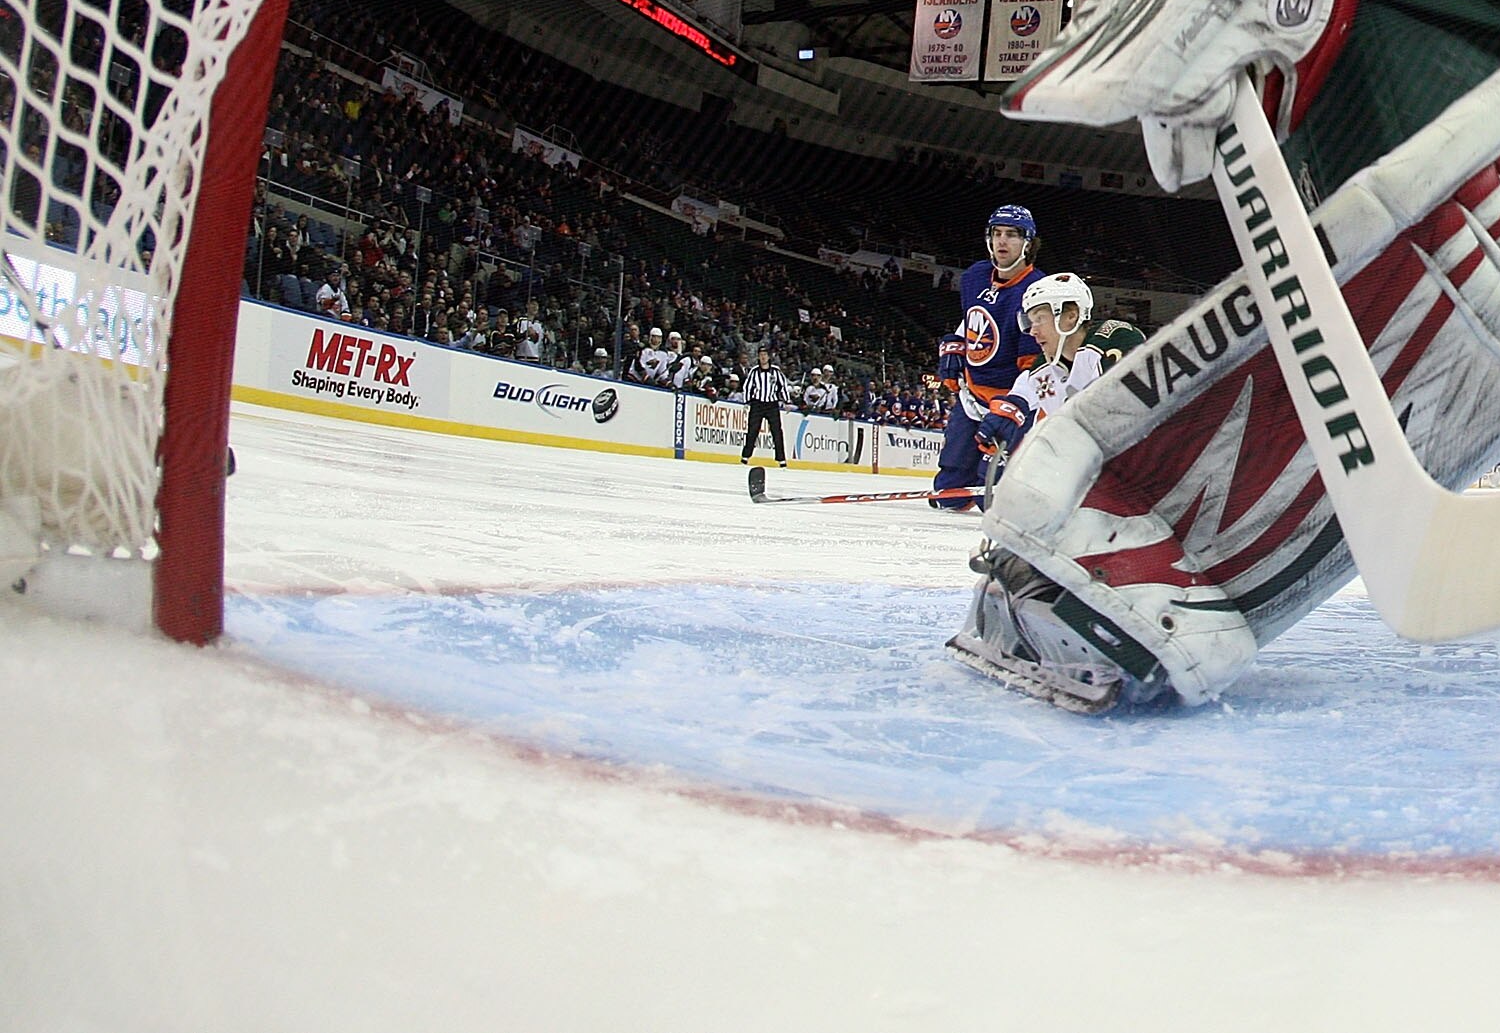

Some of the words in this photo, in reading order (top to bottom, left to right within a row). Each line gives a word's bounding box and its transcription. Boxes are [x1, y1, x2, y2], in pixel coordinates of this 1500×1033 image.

[922, 55, 951, 64] STANLEY
[954, 54, 968, 64] CUP
[924, 66, 963, 75] CHAMPIONS
[999, 53, 1029, 62] STANLEY
[1217, 123, 1376, 477] WARRIOR
[306, 328, 415, 387] MET-Rx
[292, 370, 345, 398] Shaping
[347, 380, 385, 404] Every
[386, 388, 420, 408] Body.
[493, 382, 534, 403] BUD
[542, 391, 592, 412] LIGHT
[676, 393, 685, 445] Reebok
[696, 403, 731, 428] HOCKEY
[732, 408, 748, 431] NIG
[695, 427, 729, 445] SATURDAY
[886, 432, 941, 454] Newsday
